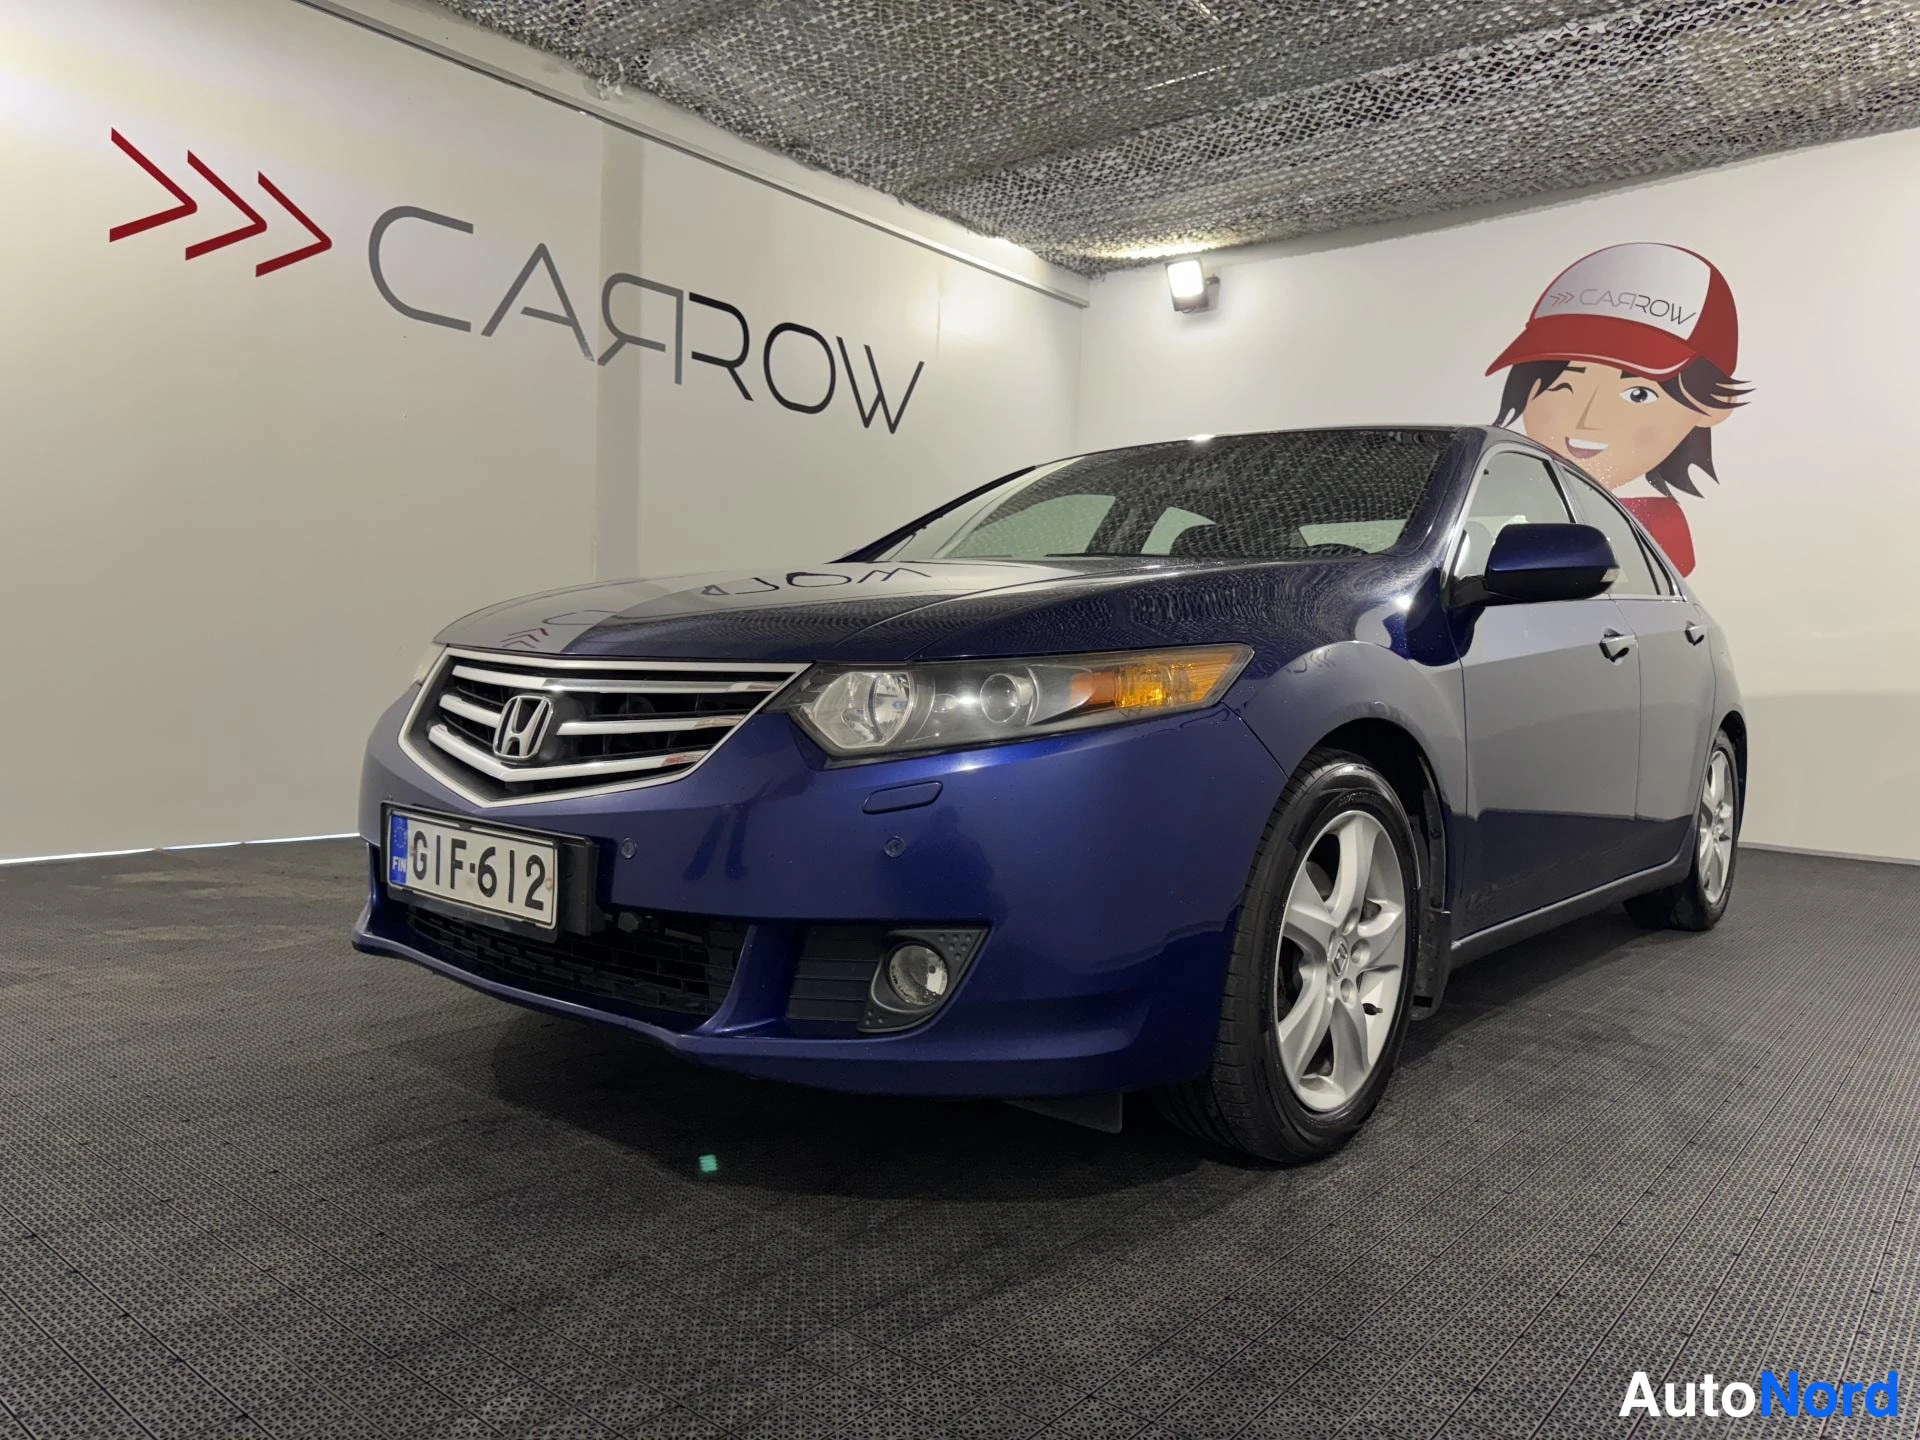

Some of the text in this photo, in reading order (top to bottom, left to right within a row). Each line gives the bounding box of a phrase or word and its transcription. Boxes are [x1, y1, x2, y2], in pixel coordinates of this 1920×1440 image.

[368, 205, 925, 435] CARROW
[1578, 288, 1697, 325] CARROW
[392, 855, 407, 873] FIN
[412, 830, 546, 911] GIF-612
